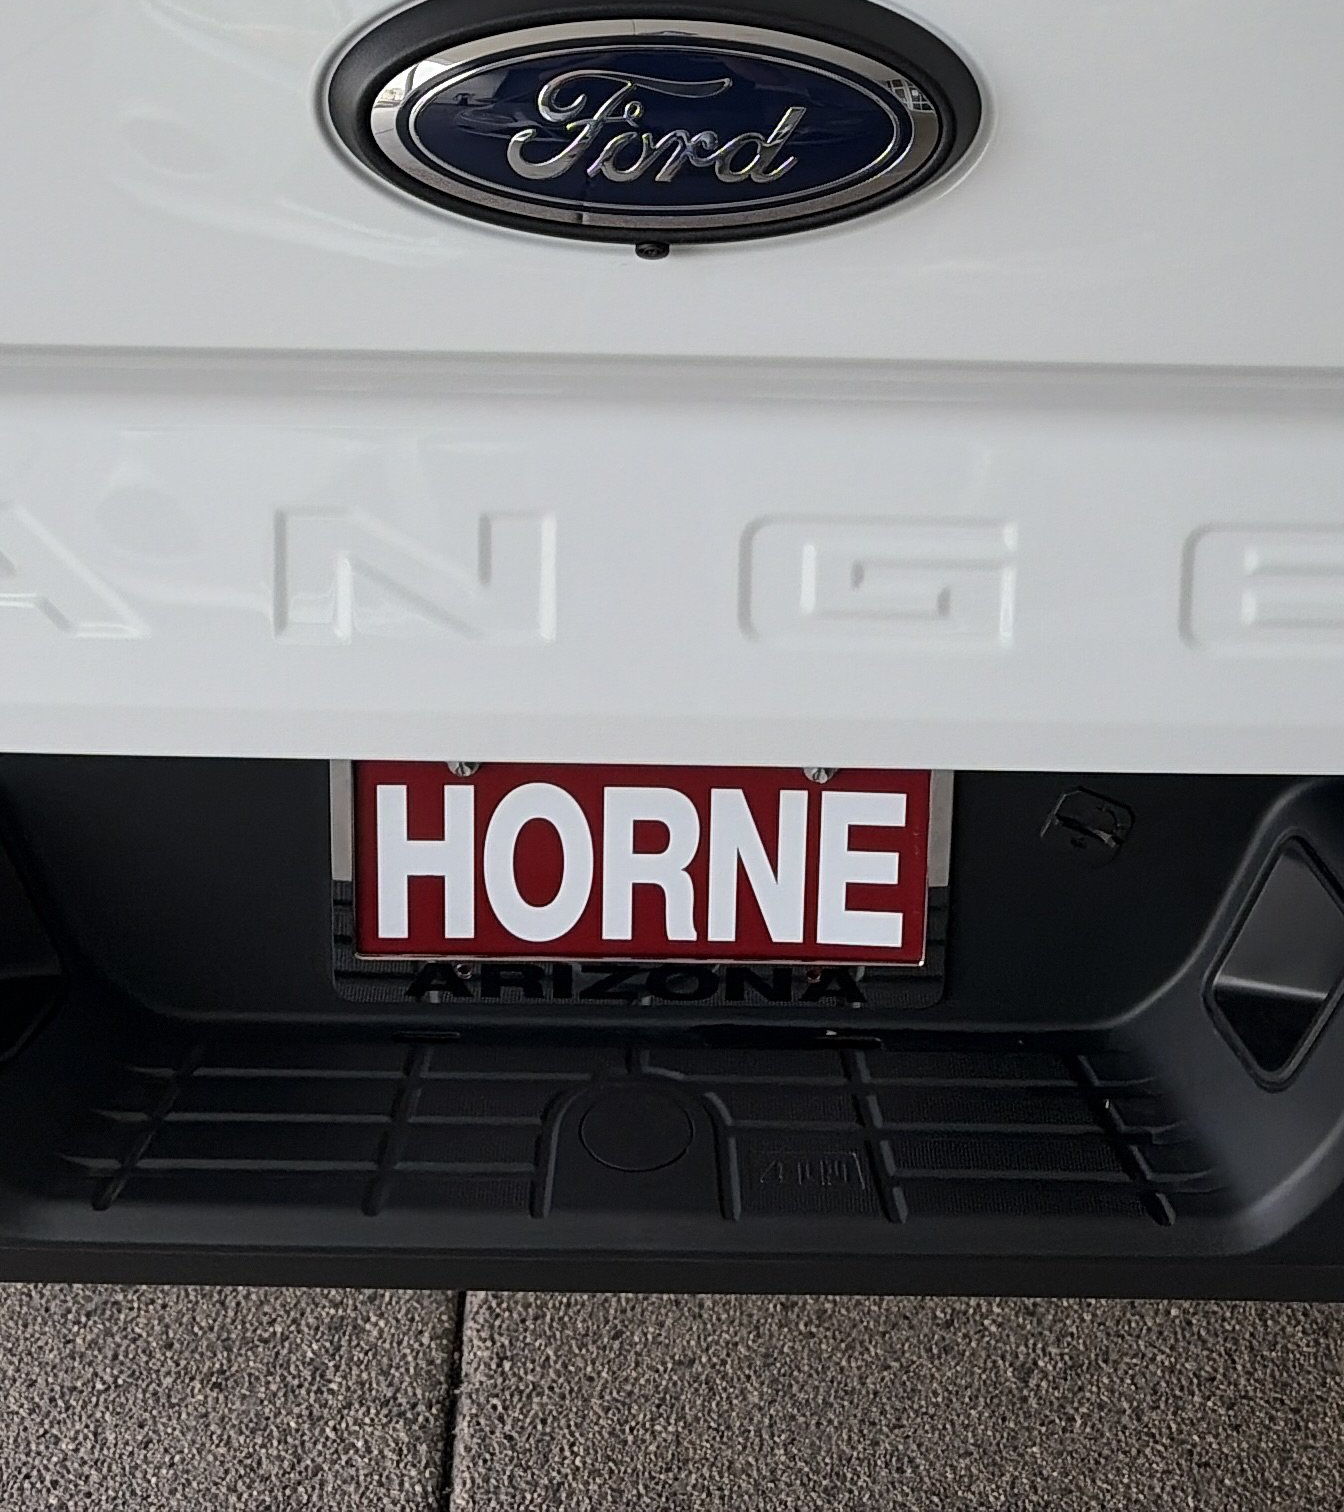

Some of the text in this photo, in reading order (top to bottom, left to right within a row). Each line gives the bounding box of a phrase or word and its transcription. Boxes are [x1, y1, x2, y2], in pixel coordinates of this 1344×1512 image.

[506, 69, 806, 184] Ford
[375, 781, 908, 949] HORNE
[404, 960, 868, 1004] ARIZONA
